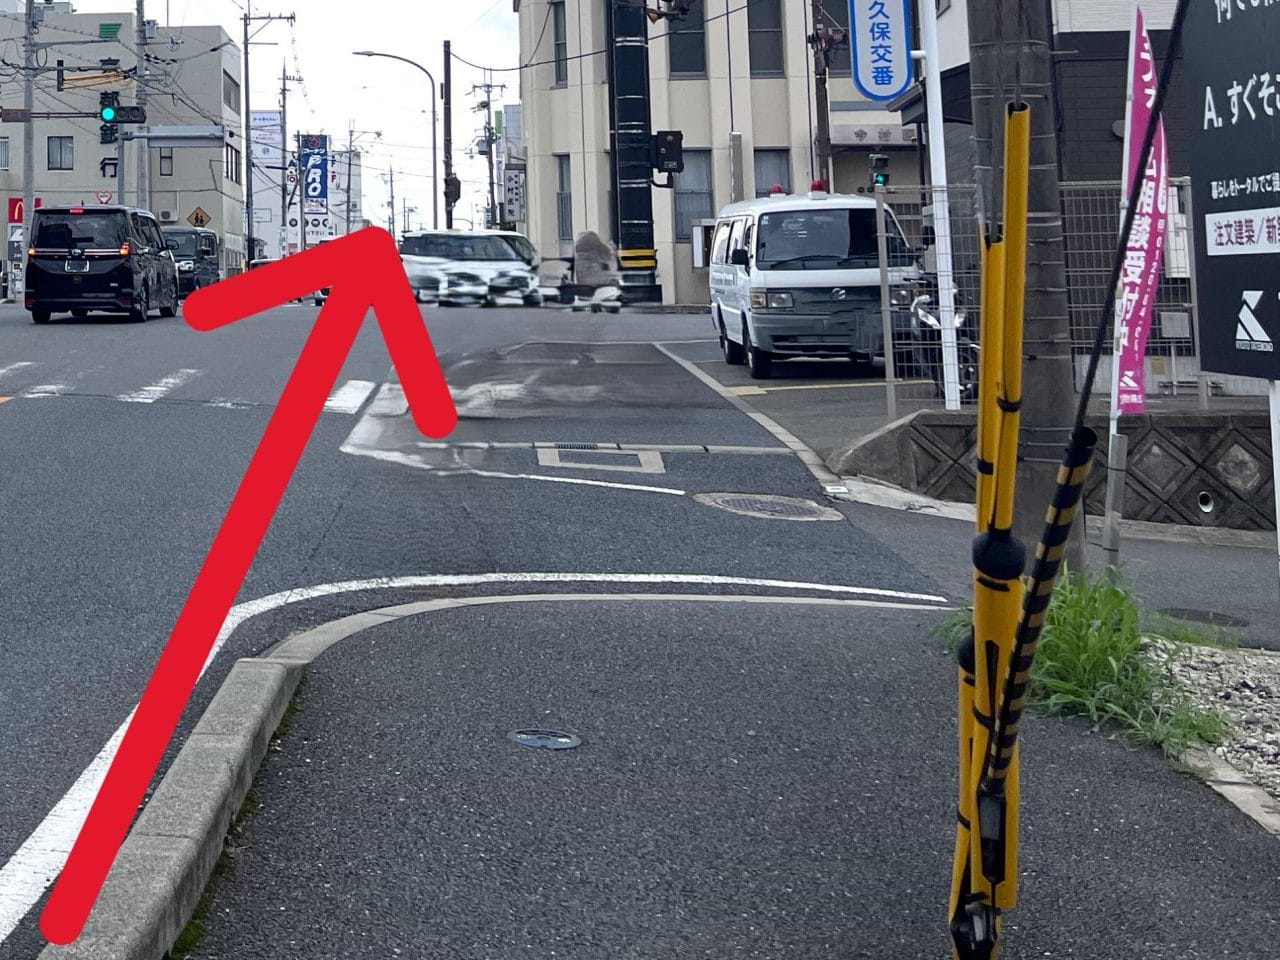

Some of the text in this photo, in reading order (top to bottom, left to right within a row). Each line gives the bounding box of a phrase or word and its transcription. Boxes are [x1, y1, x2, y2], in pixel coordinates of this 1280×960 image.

[1227, 70, 1280, 125] すぐそ
[306, 154, 322, 197] PRO
